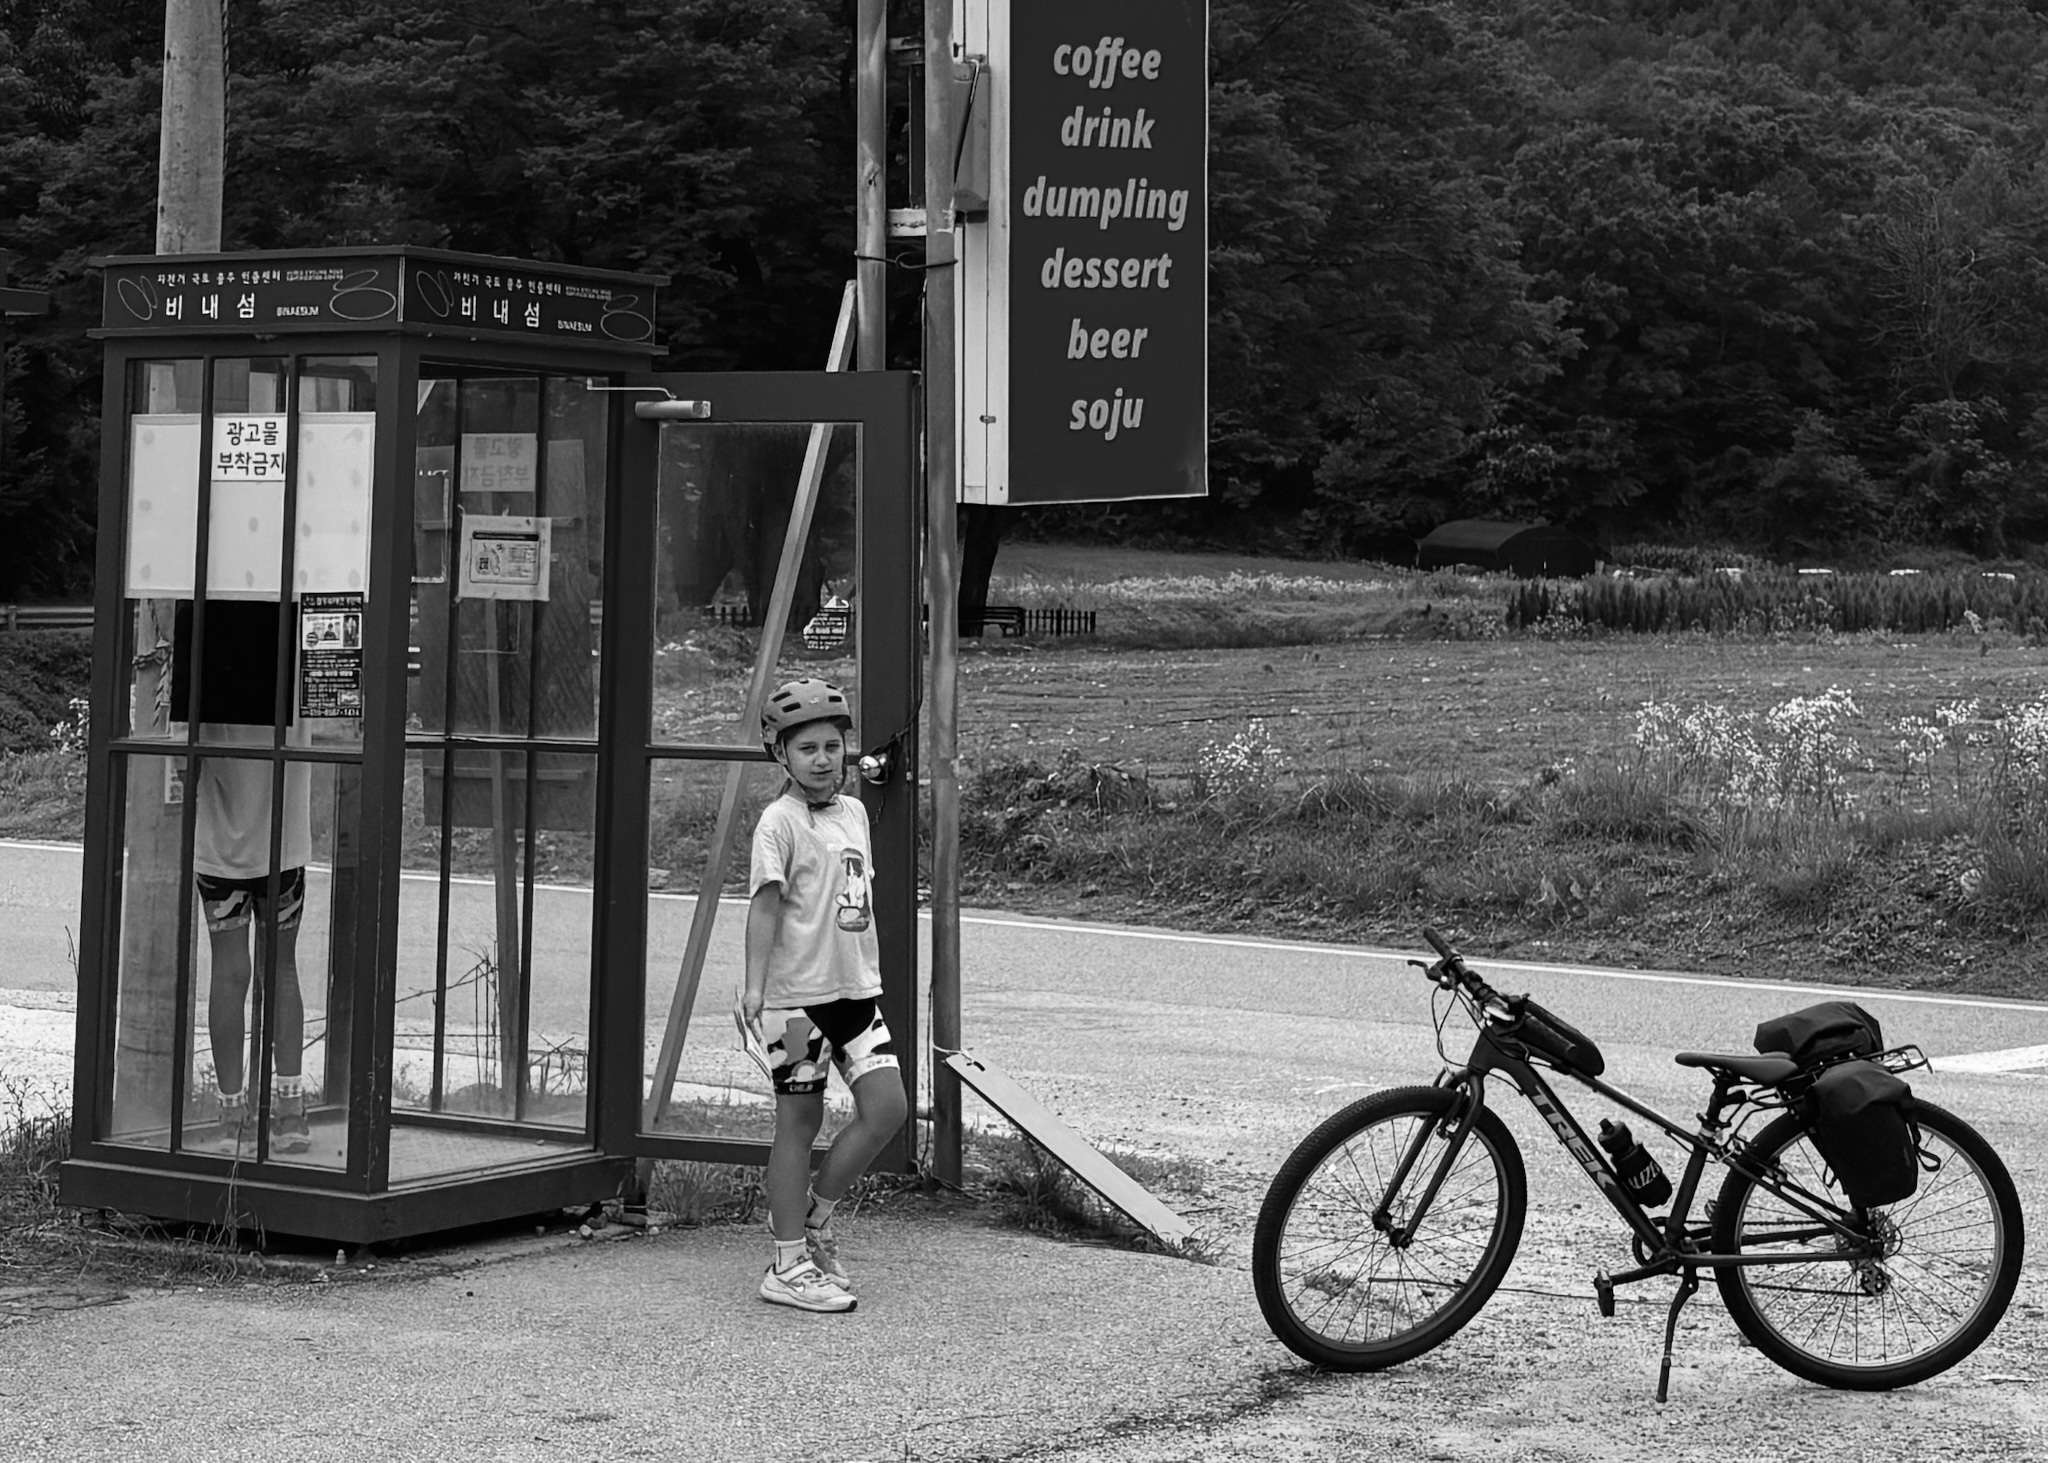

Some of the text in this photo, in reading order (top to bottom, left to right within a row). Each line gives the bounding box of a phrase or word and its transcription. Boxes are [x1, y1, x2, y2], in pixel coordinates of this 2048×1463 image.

[1053, 36, 1162, 89] coffee
[1060, 105, 1155, 149] drink
[1022, 175, 1189, 231] dumpling
[1040, 247, 1172, 289] dessert
[1067, 318, 1148, 360] beer
[226, 421, 279, 446] 광고물
[1069, 387, 1144, 441] soju
[217, 451, 285, 476] 부착금지
[1531, 1085, 1617, 1189] TREK
